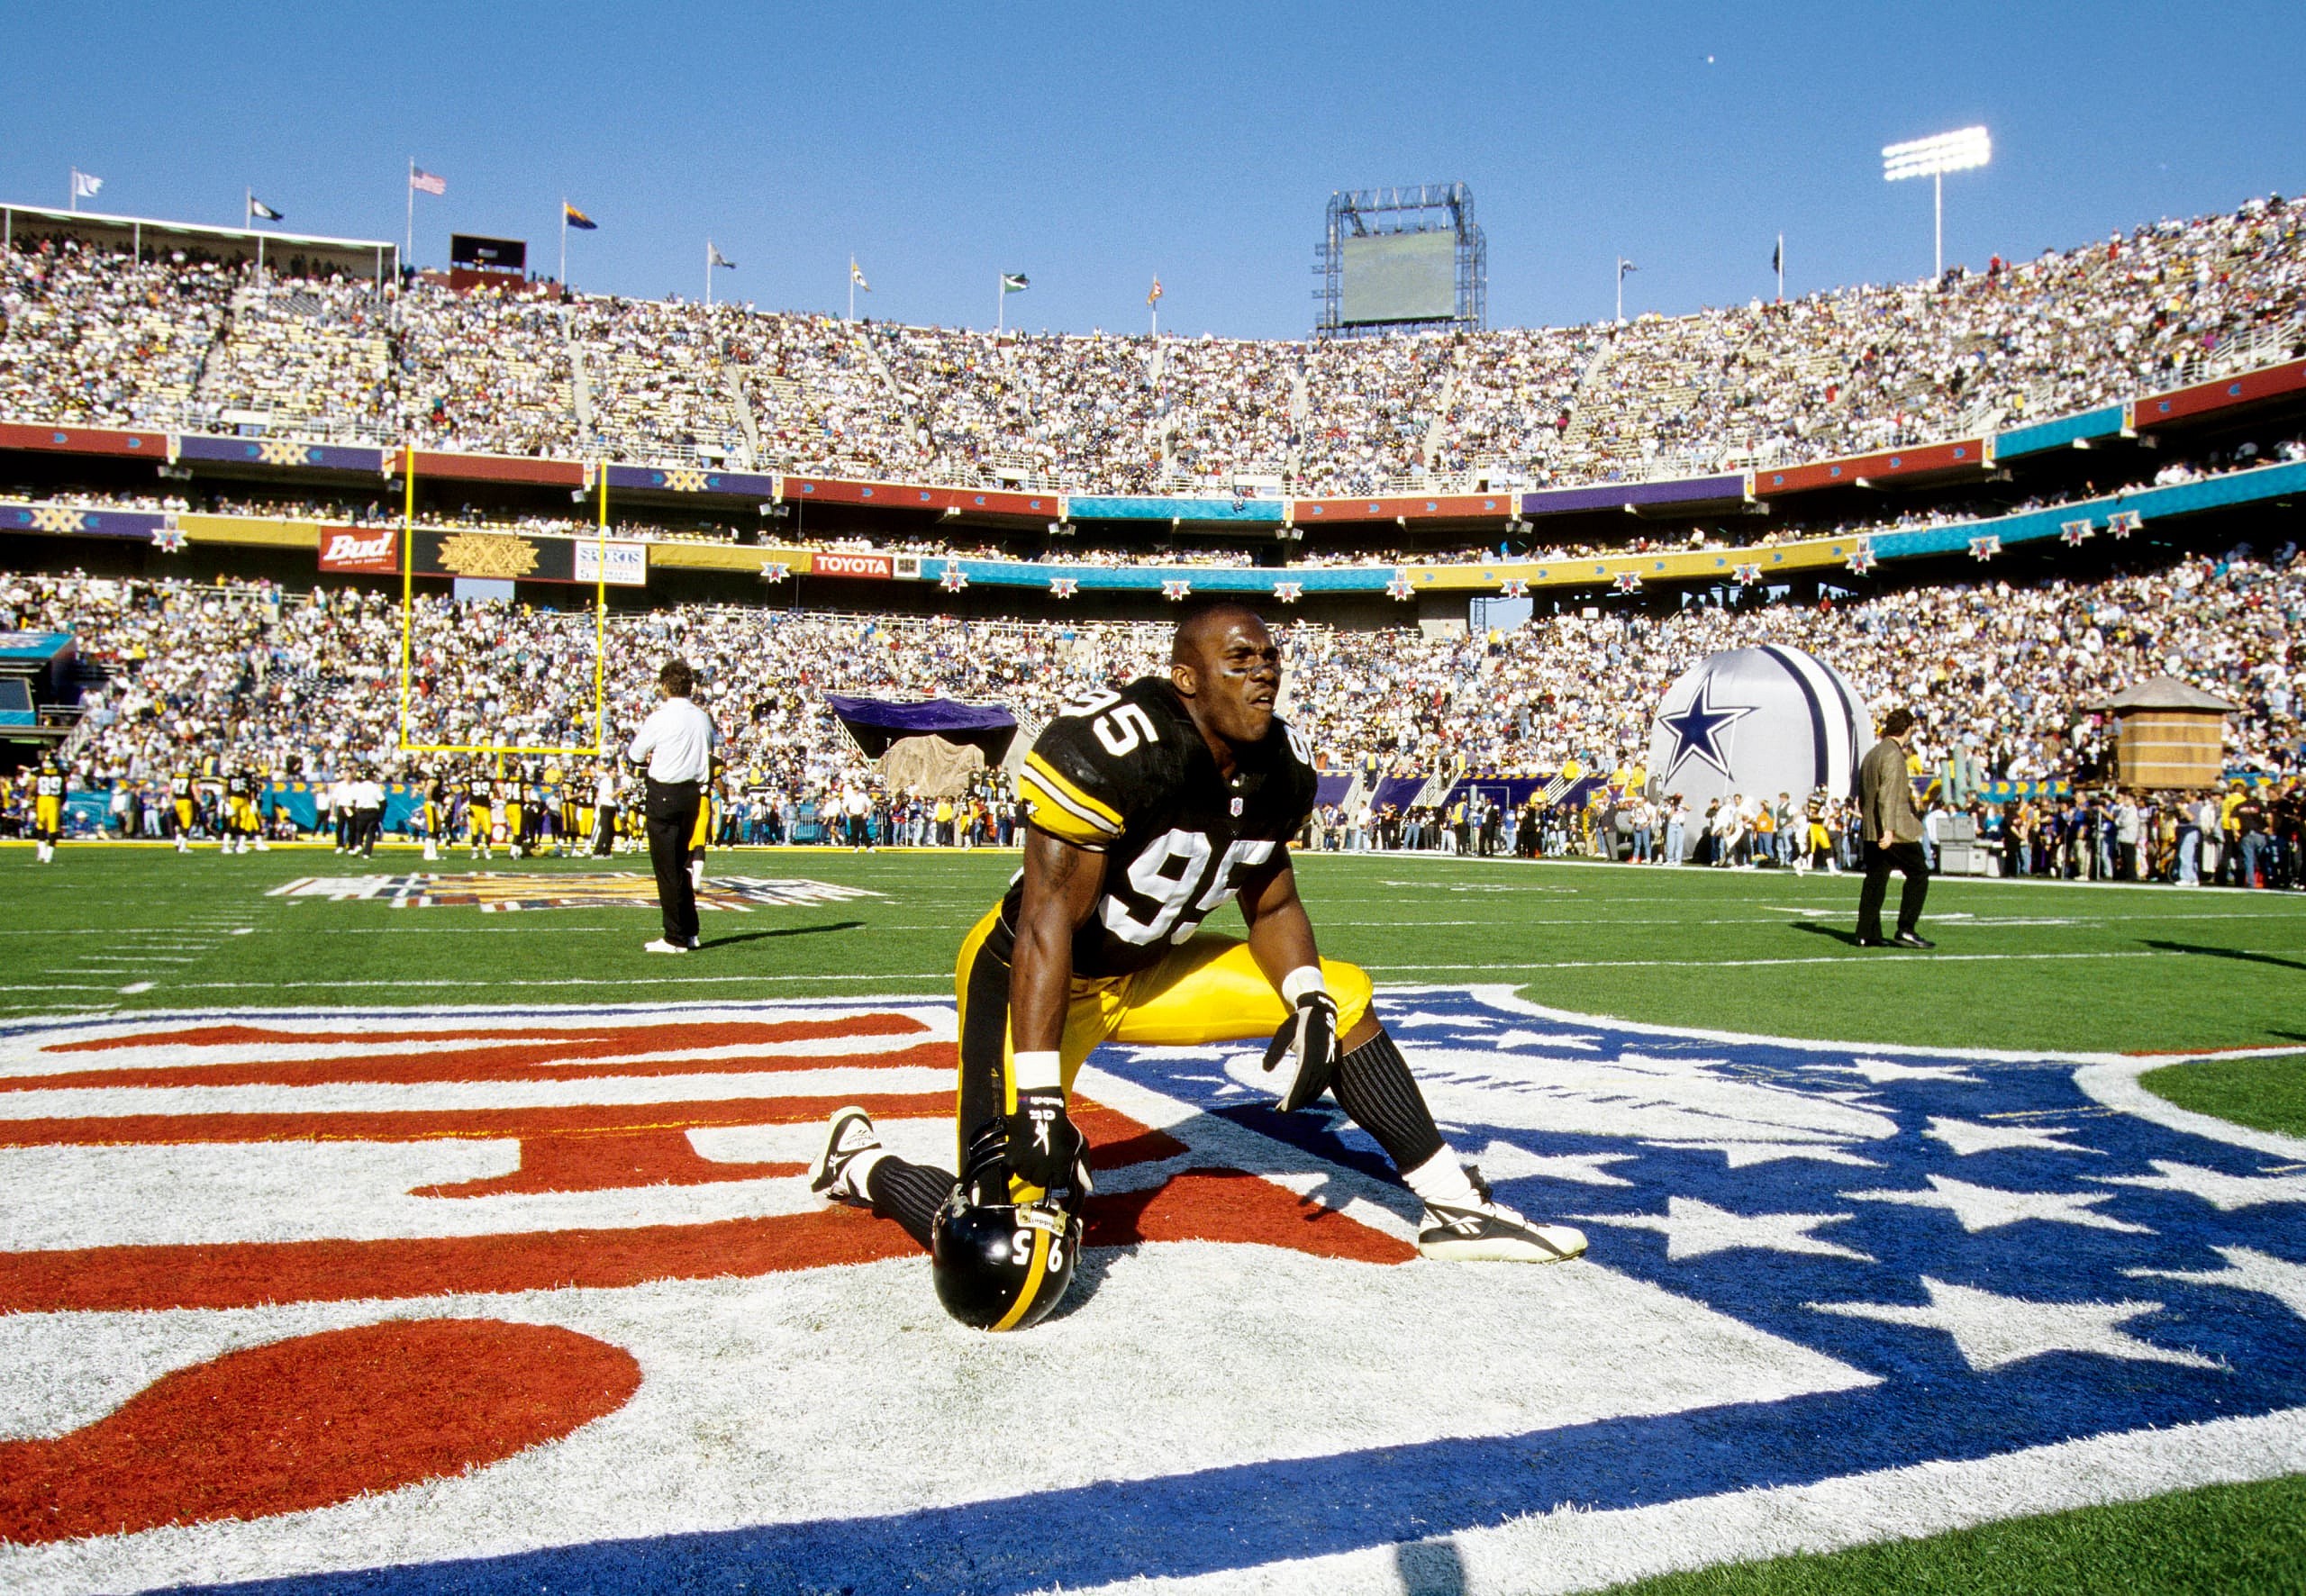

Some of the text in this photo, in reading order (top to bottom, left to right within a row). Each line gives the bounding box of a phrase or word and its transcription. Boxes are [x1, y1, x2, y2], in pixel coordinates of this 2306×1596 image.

[259, 442, 310, 466] XXX
[664, 470, 708, 492] XXX
[31, 508, 86, 532] XXX
[816, 556, 888, 575] TOYOTA
[1058, 689, 1159, 757] 95
[471, 781, 491, 796] 99
[1098, 828, 1276, 947] 95
